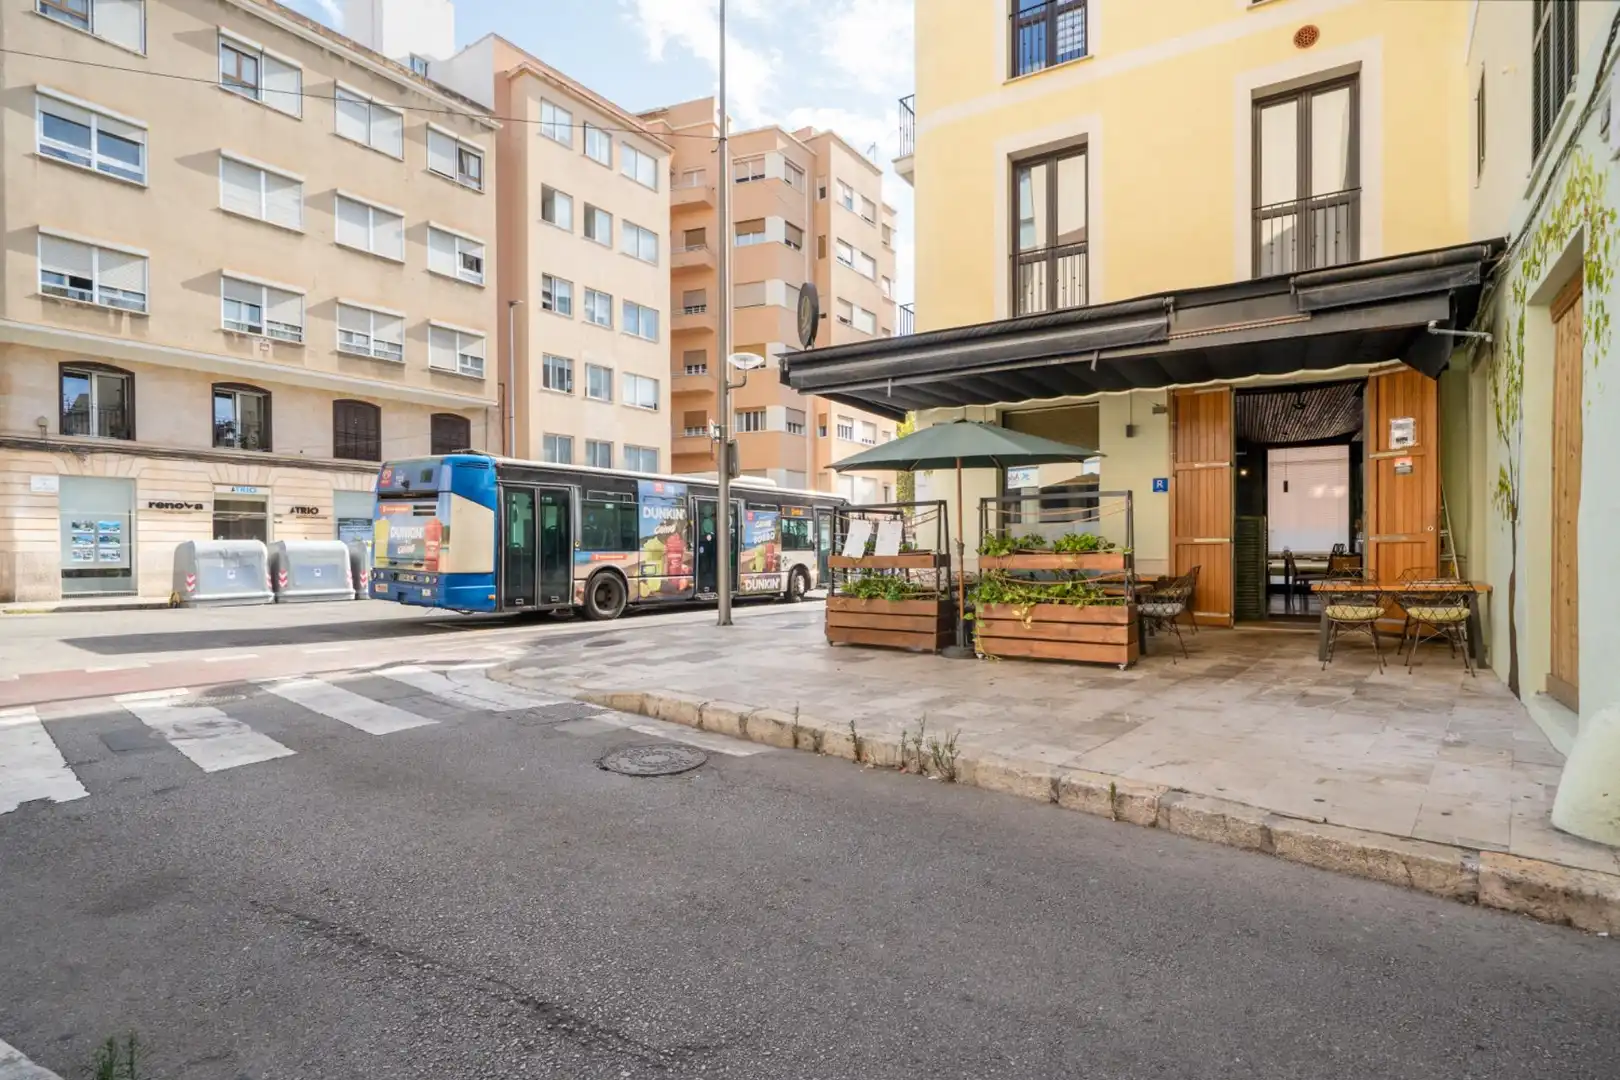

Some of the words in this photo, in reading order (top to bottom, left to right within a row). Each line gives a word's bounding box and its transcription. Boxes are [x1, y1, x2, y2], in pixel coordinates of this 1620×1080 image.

[1156, 479, 1164, 489] R
[148, 501, 203, 510] renova
[290, 506, 319, 514] ATRIO
